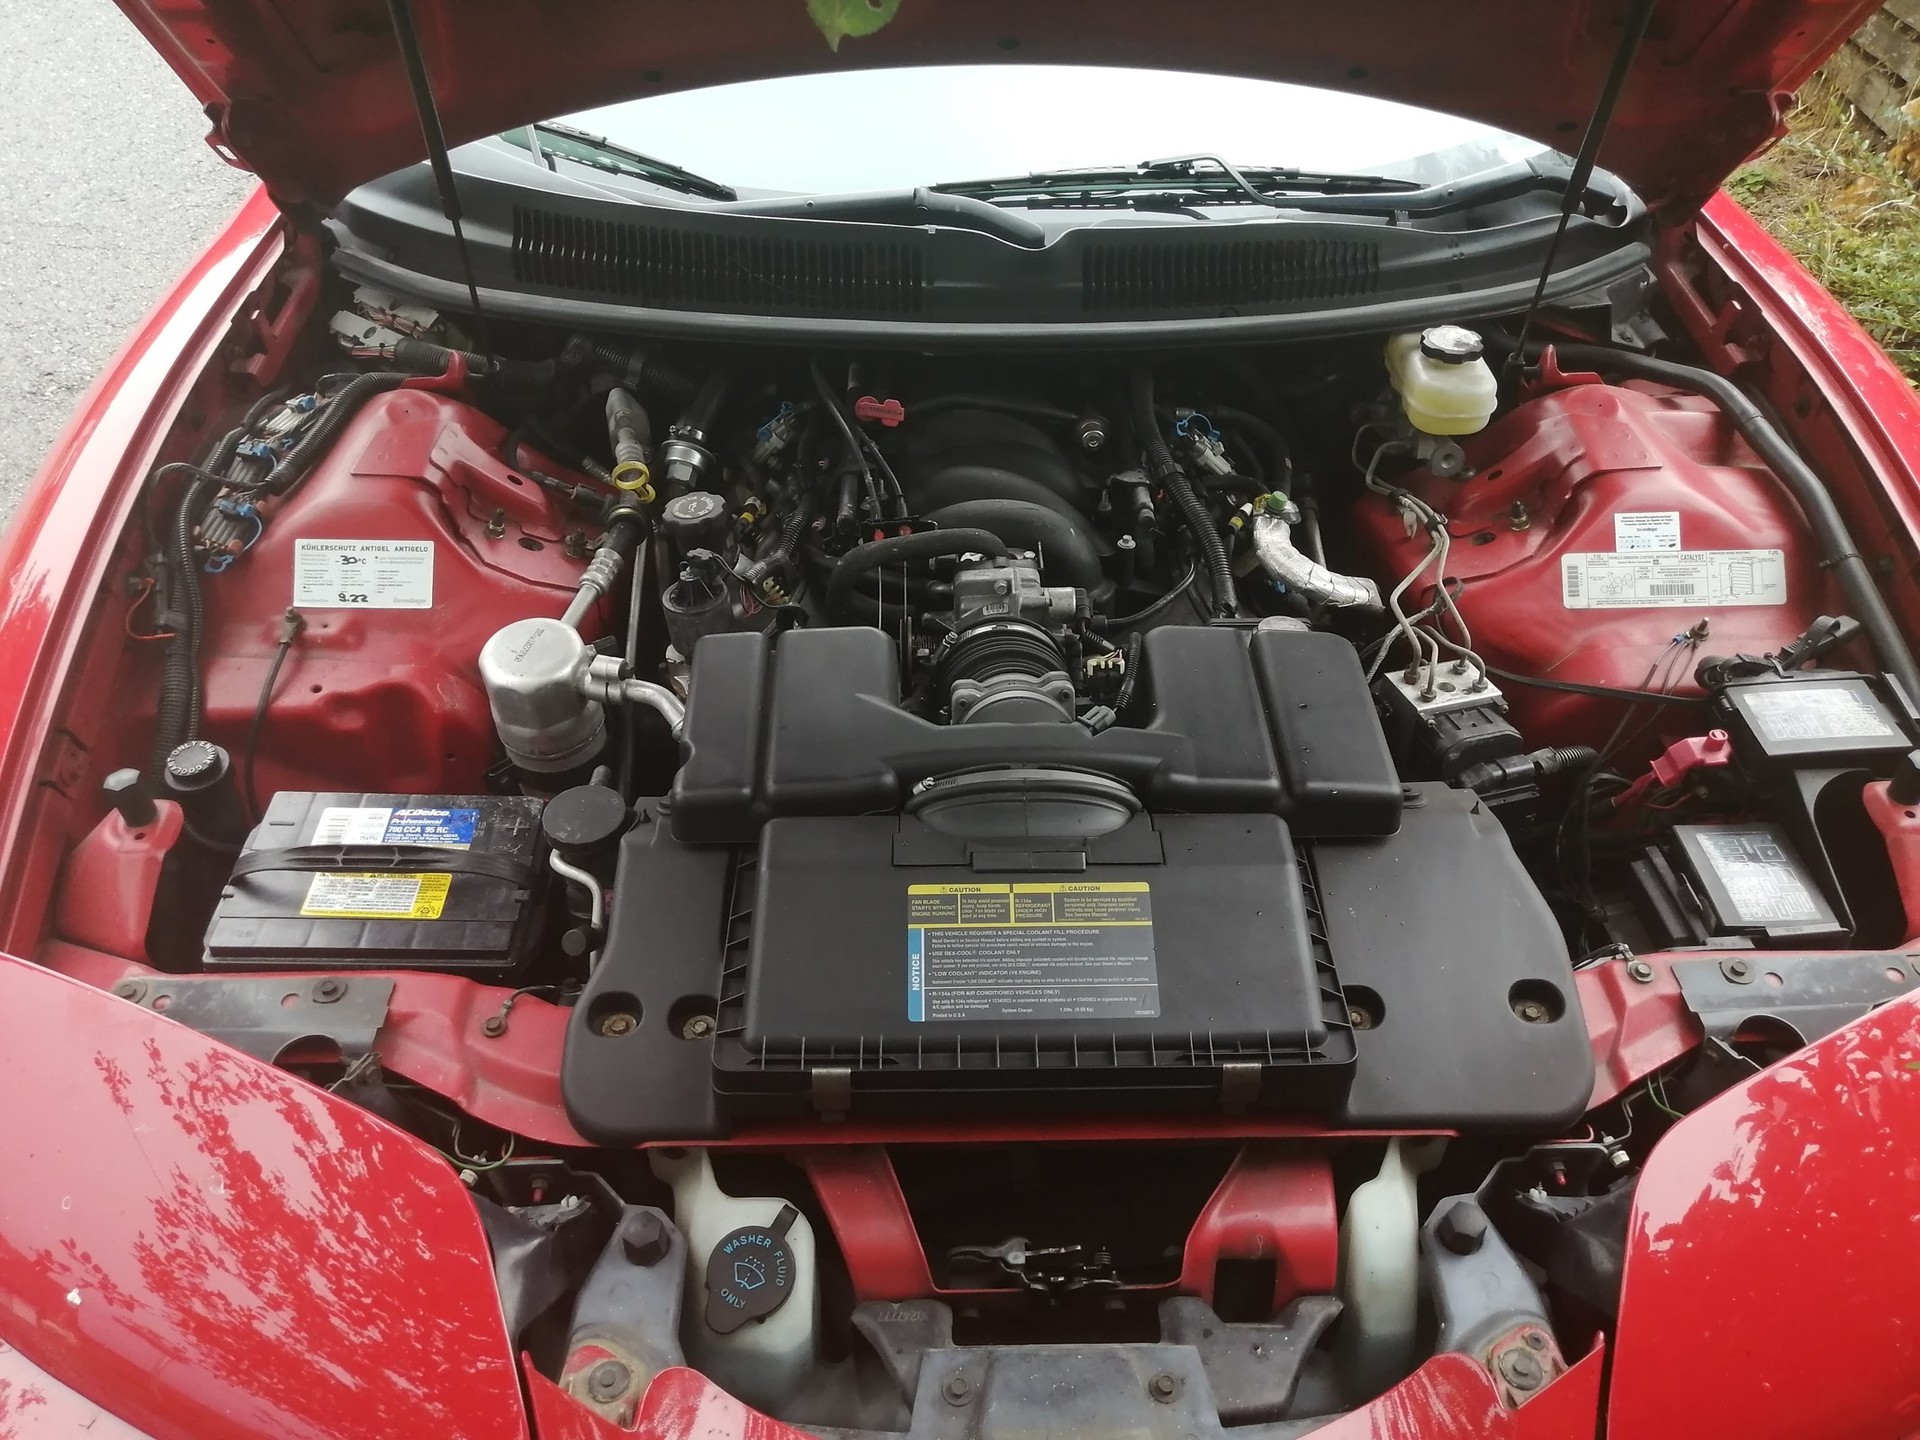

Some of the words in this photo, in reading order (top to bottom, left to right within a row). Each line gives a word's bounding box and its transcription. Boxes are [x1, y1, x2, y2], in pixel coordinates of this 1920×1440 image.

[172, 741, 198, 755] ONLY
[200, 741, 215, 764] ENGINE
[167, 758, 202, 774] COOLANT
[723, 1234, 772, 1255] WASHER
[774, 1250, 786, 1287] FLUID
[720, 1288, 746, 1308] ONLY
